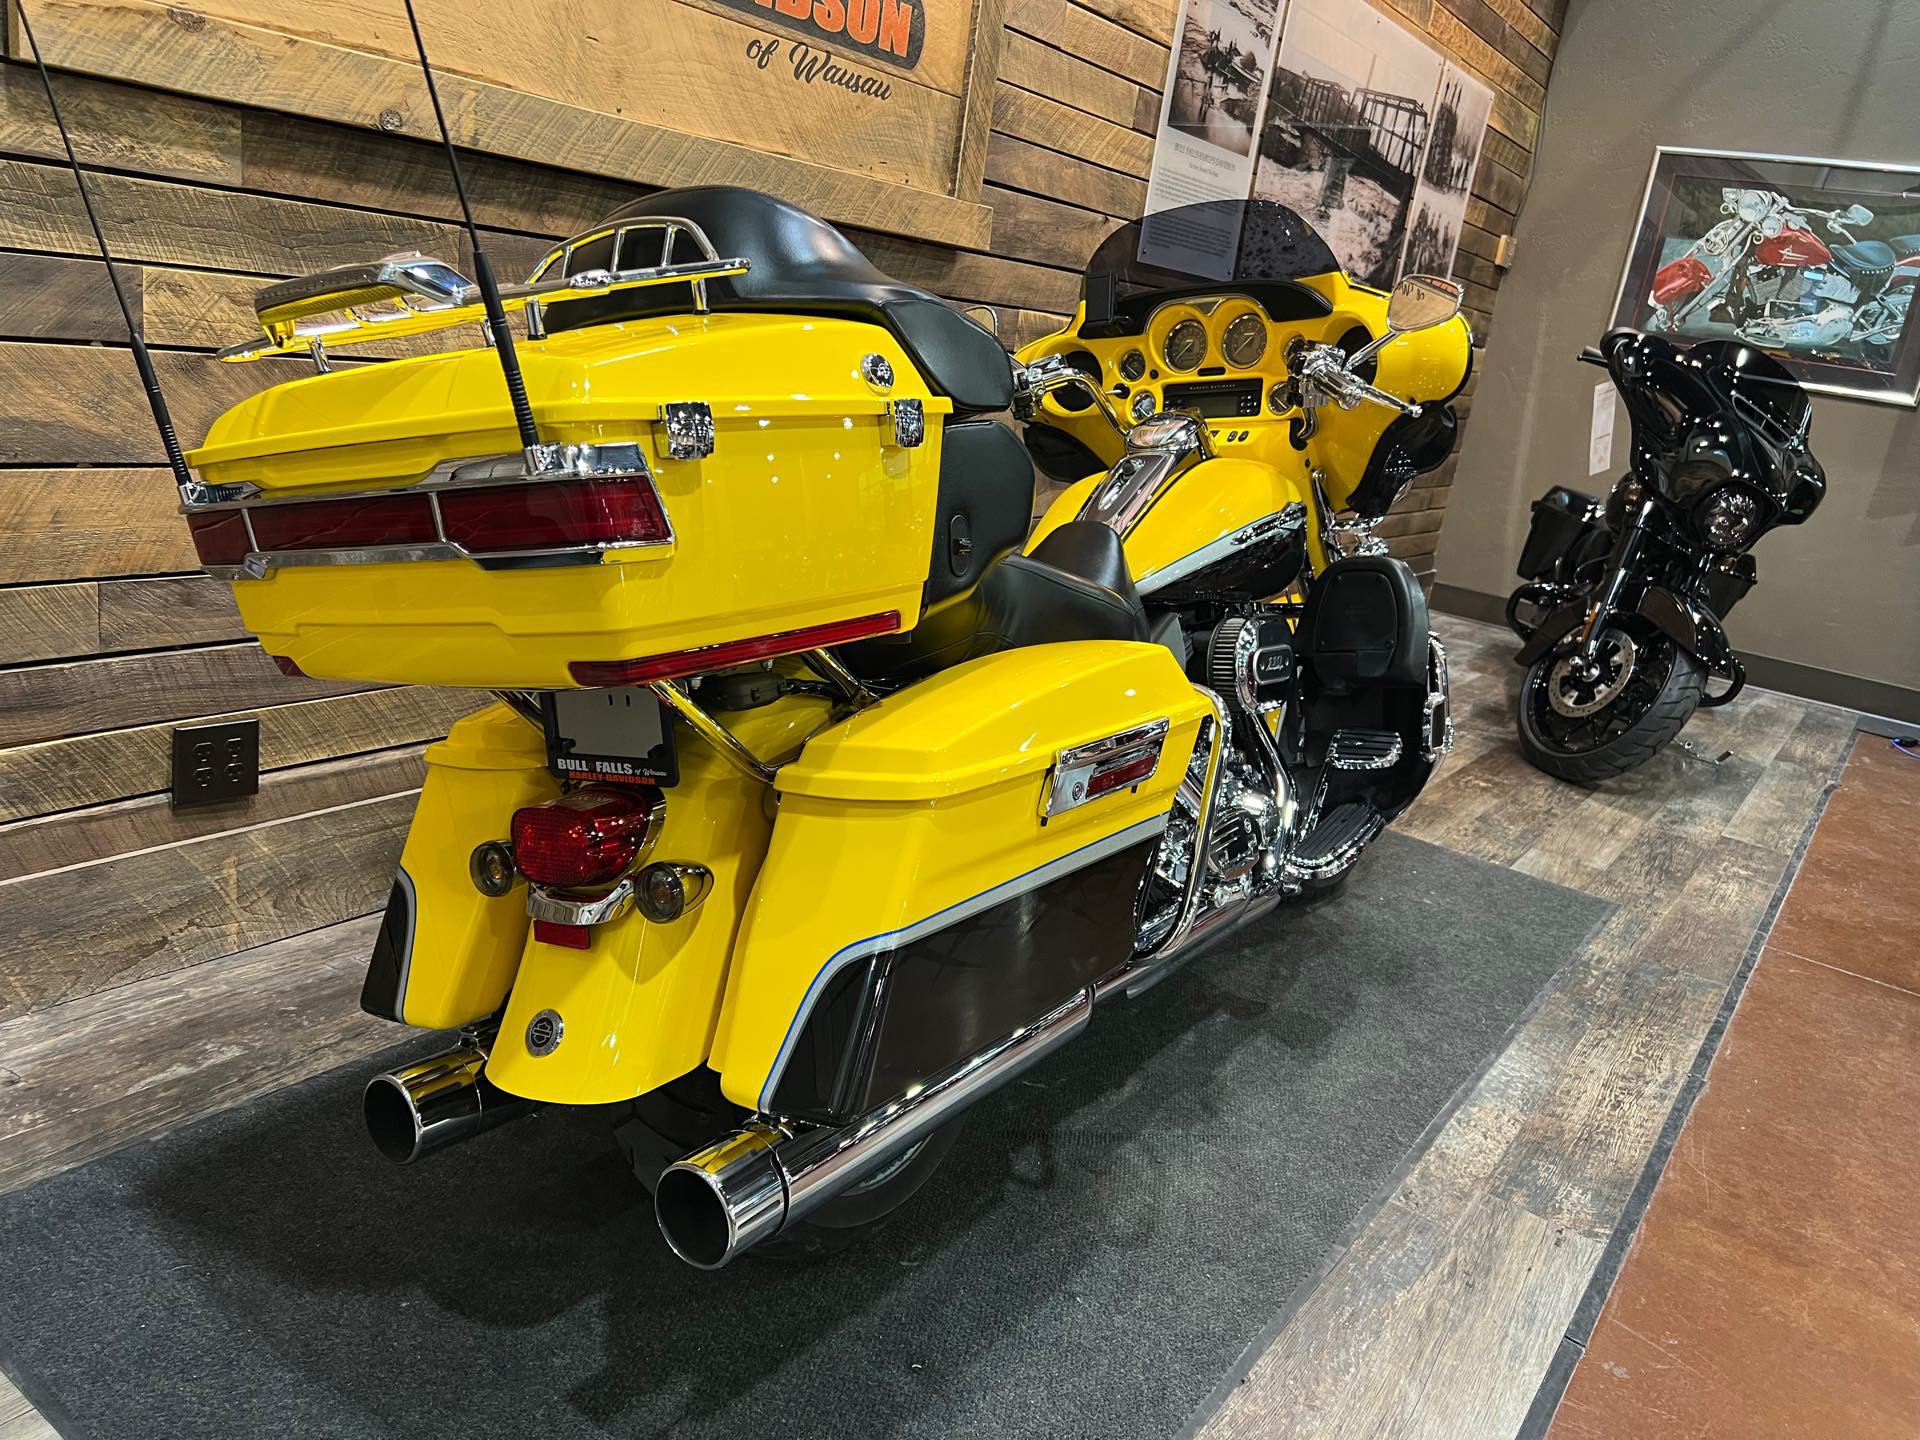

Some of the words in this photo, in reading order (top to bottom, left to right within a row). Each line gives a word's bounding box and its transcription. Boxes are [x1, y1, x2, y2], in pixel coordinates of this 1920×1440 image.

[746, 39, 779, 70] of
[788, 42, 892, 101] Wausau
[557, 759, 588, 771] BULL
[596, 762, 632, 774] FALLS
[569, 771, 656, 784] HARLEY-DAVIDSON
